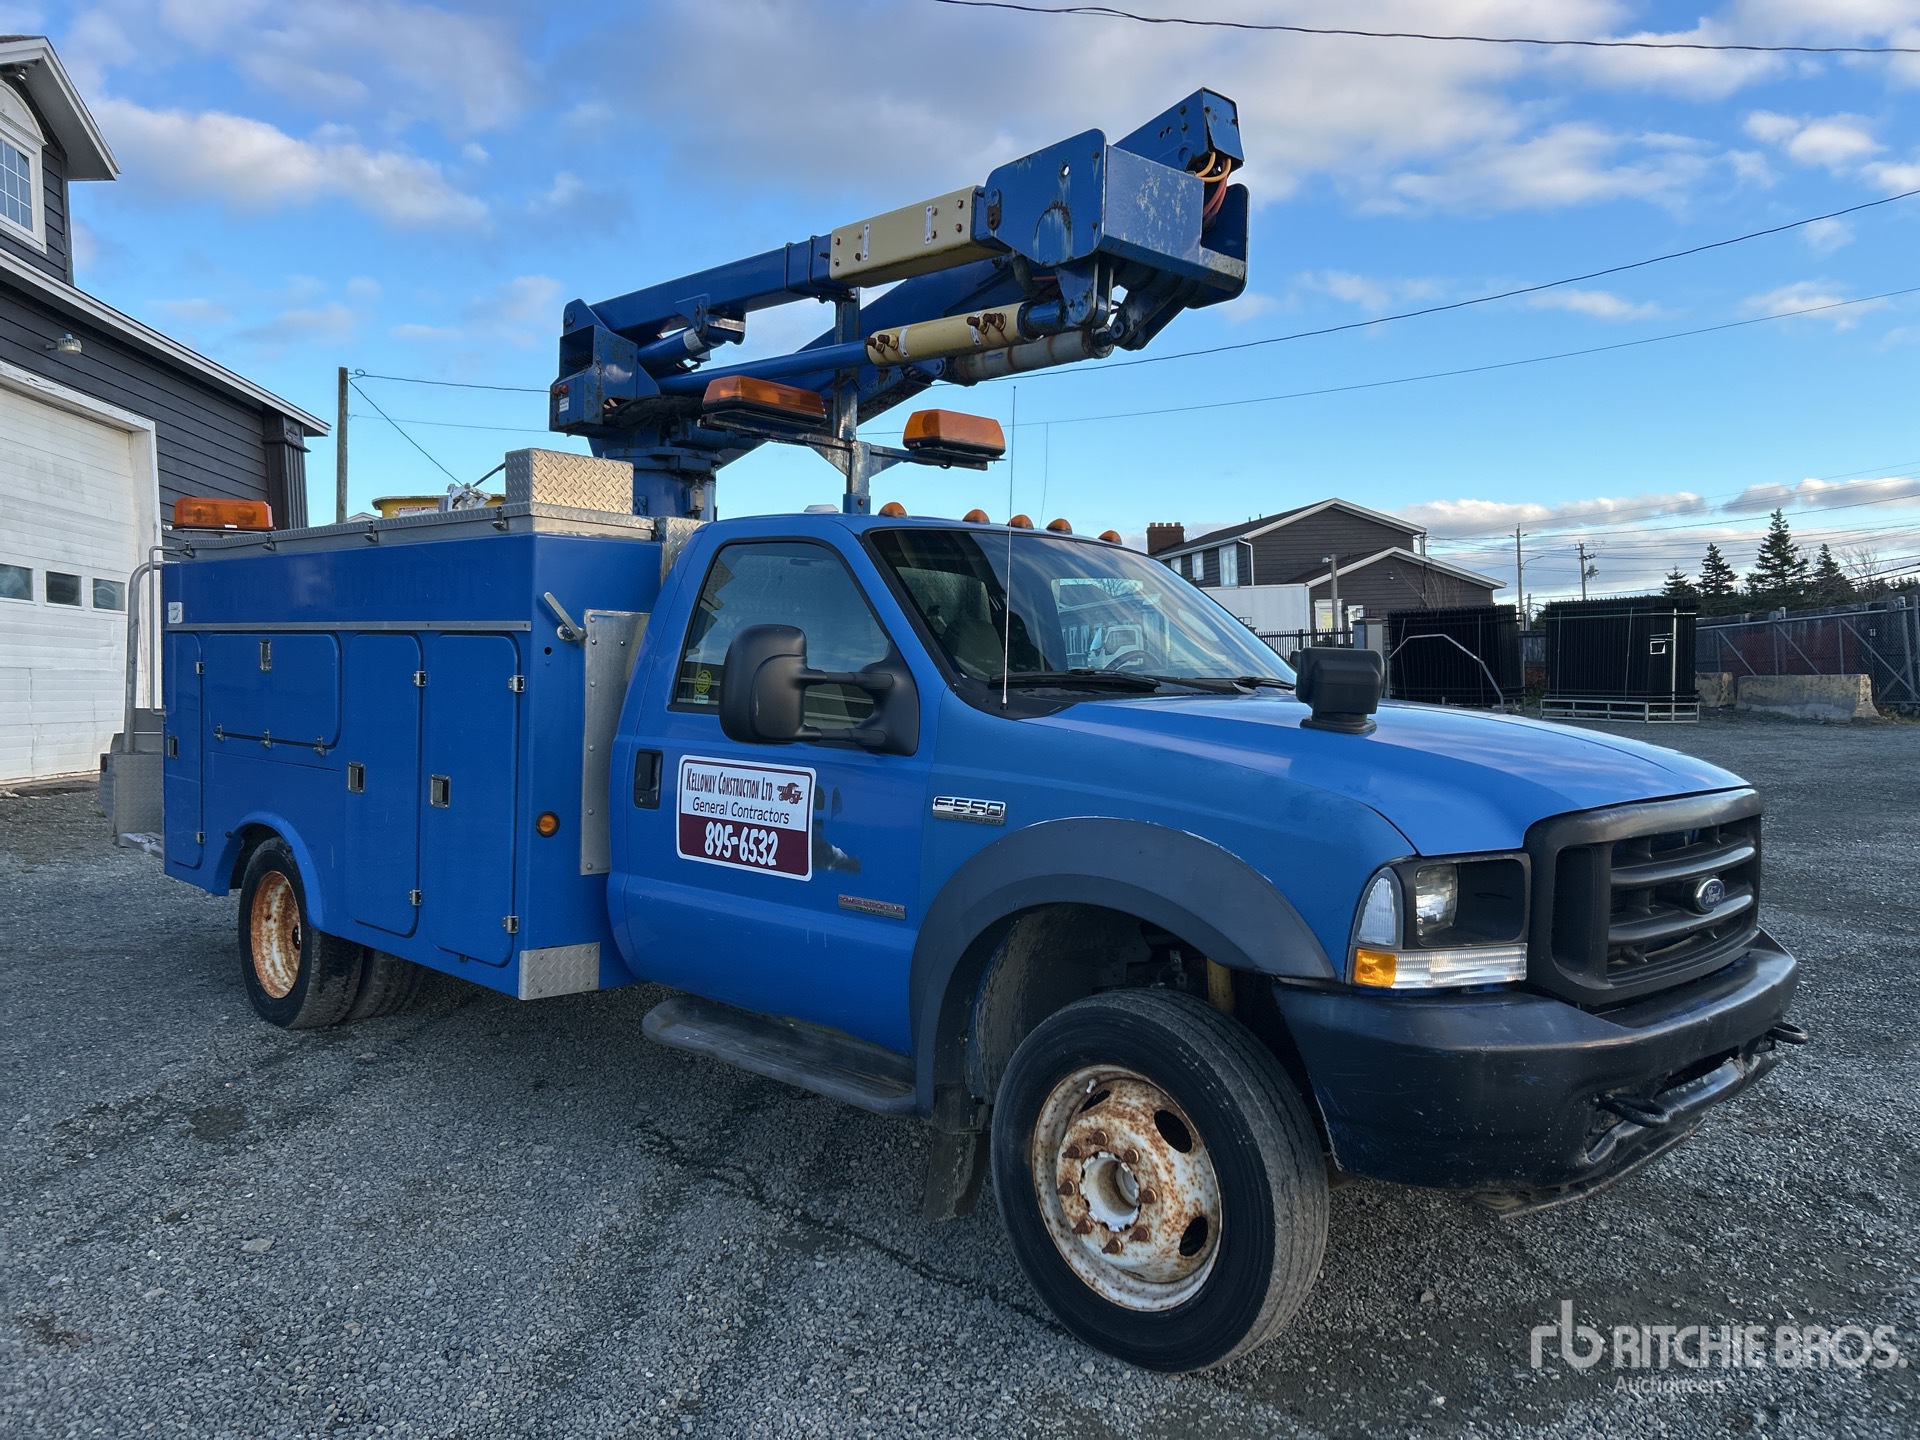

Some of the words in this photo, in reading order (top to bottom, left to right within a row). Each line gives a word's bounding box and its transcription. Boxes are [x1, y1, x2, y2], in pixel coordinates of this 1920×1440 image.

[686, 768, 717, 795] KELLOWAY
[718, 772, 760, 800] CONSTRUCTION
[761, 777, 774, 802] LTD.
[692, 796, 728, 816] General
[731, 802, 790, 825] Contractors
[704, 821, 779, 867] 895-6532
